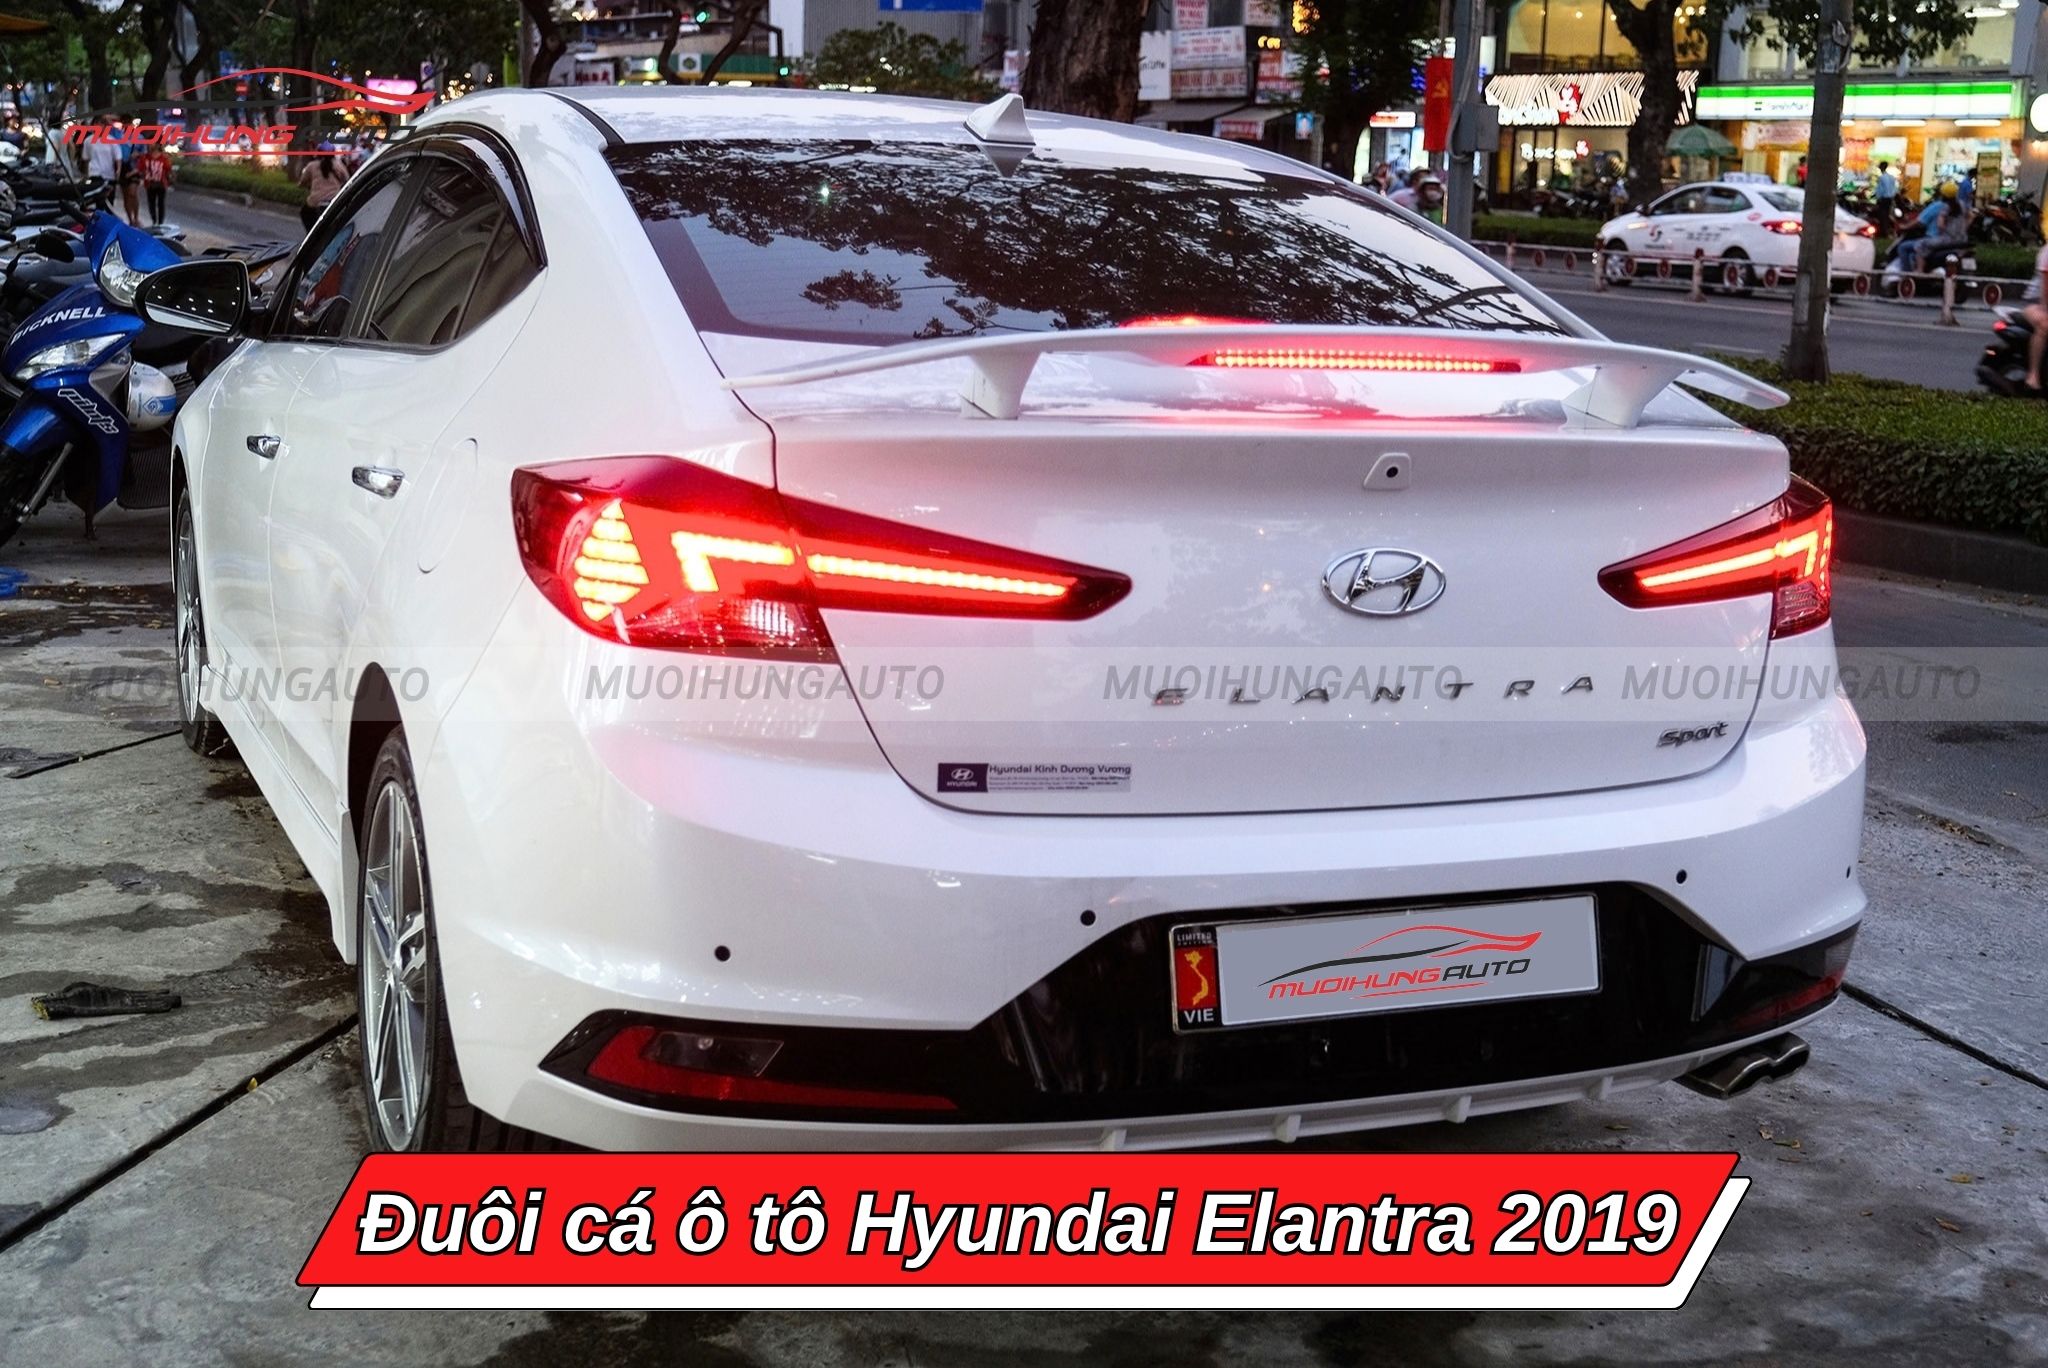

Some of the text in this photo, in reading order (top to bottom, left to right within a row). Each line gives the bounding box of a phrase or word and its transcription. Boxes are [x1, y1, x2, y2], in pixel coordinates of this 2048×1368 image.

[1152, 674, 1596, 706] ELANTRA
[1656, 719, 1729, 748] Sport
[988, 764, 1032, 776] Hyundai
[1034, 764, 1058, 774] Kinh
[1183, 1007, 1215, 1024] VIE
